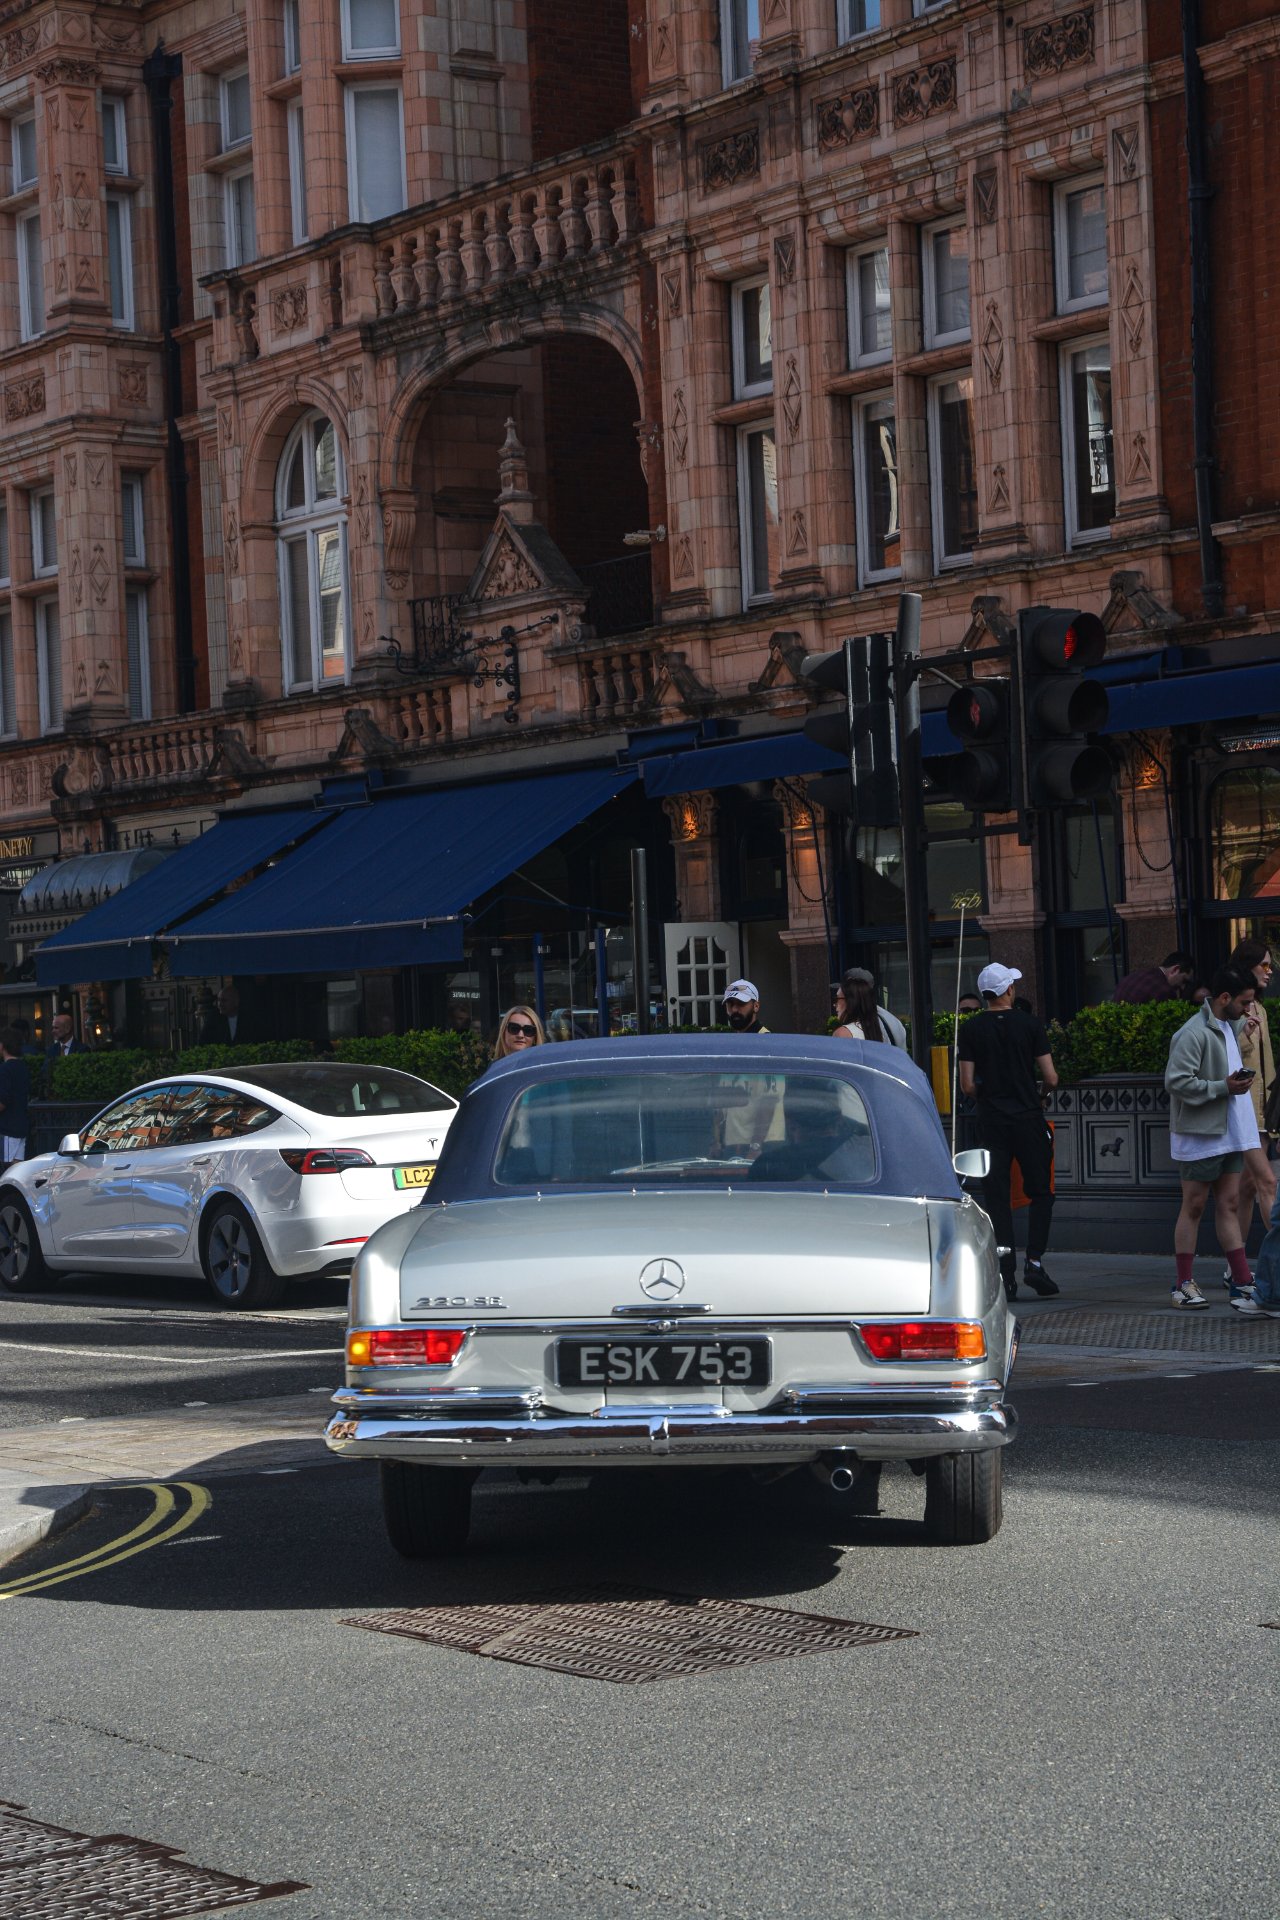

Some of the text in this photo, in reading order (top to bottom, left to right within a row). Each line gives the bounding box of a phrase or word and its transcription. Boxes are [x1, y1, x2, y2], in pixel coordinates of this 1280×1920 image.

[404, 1168, 436, 1184] LC2
[416, 1296, 503, 1307] 220 SE
[580, 1346, 752, 1381] ESK 753
